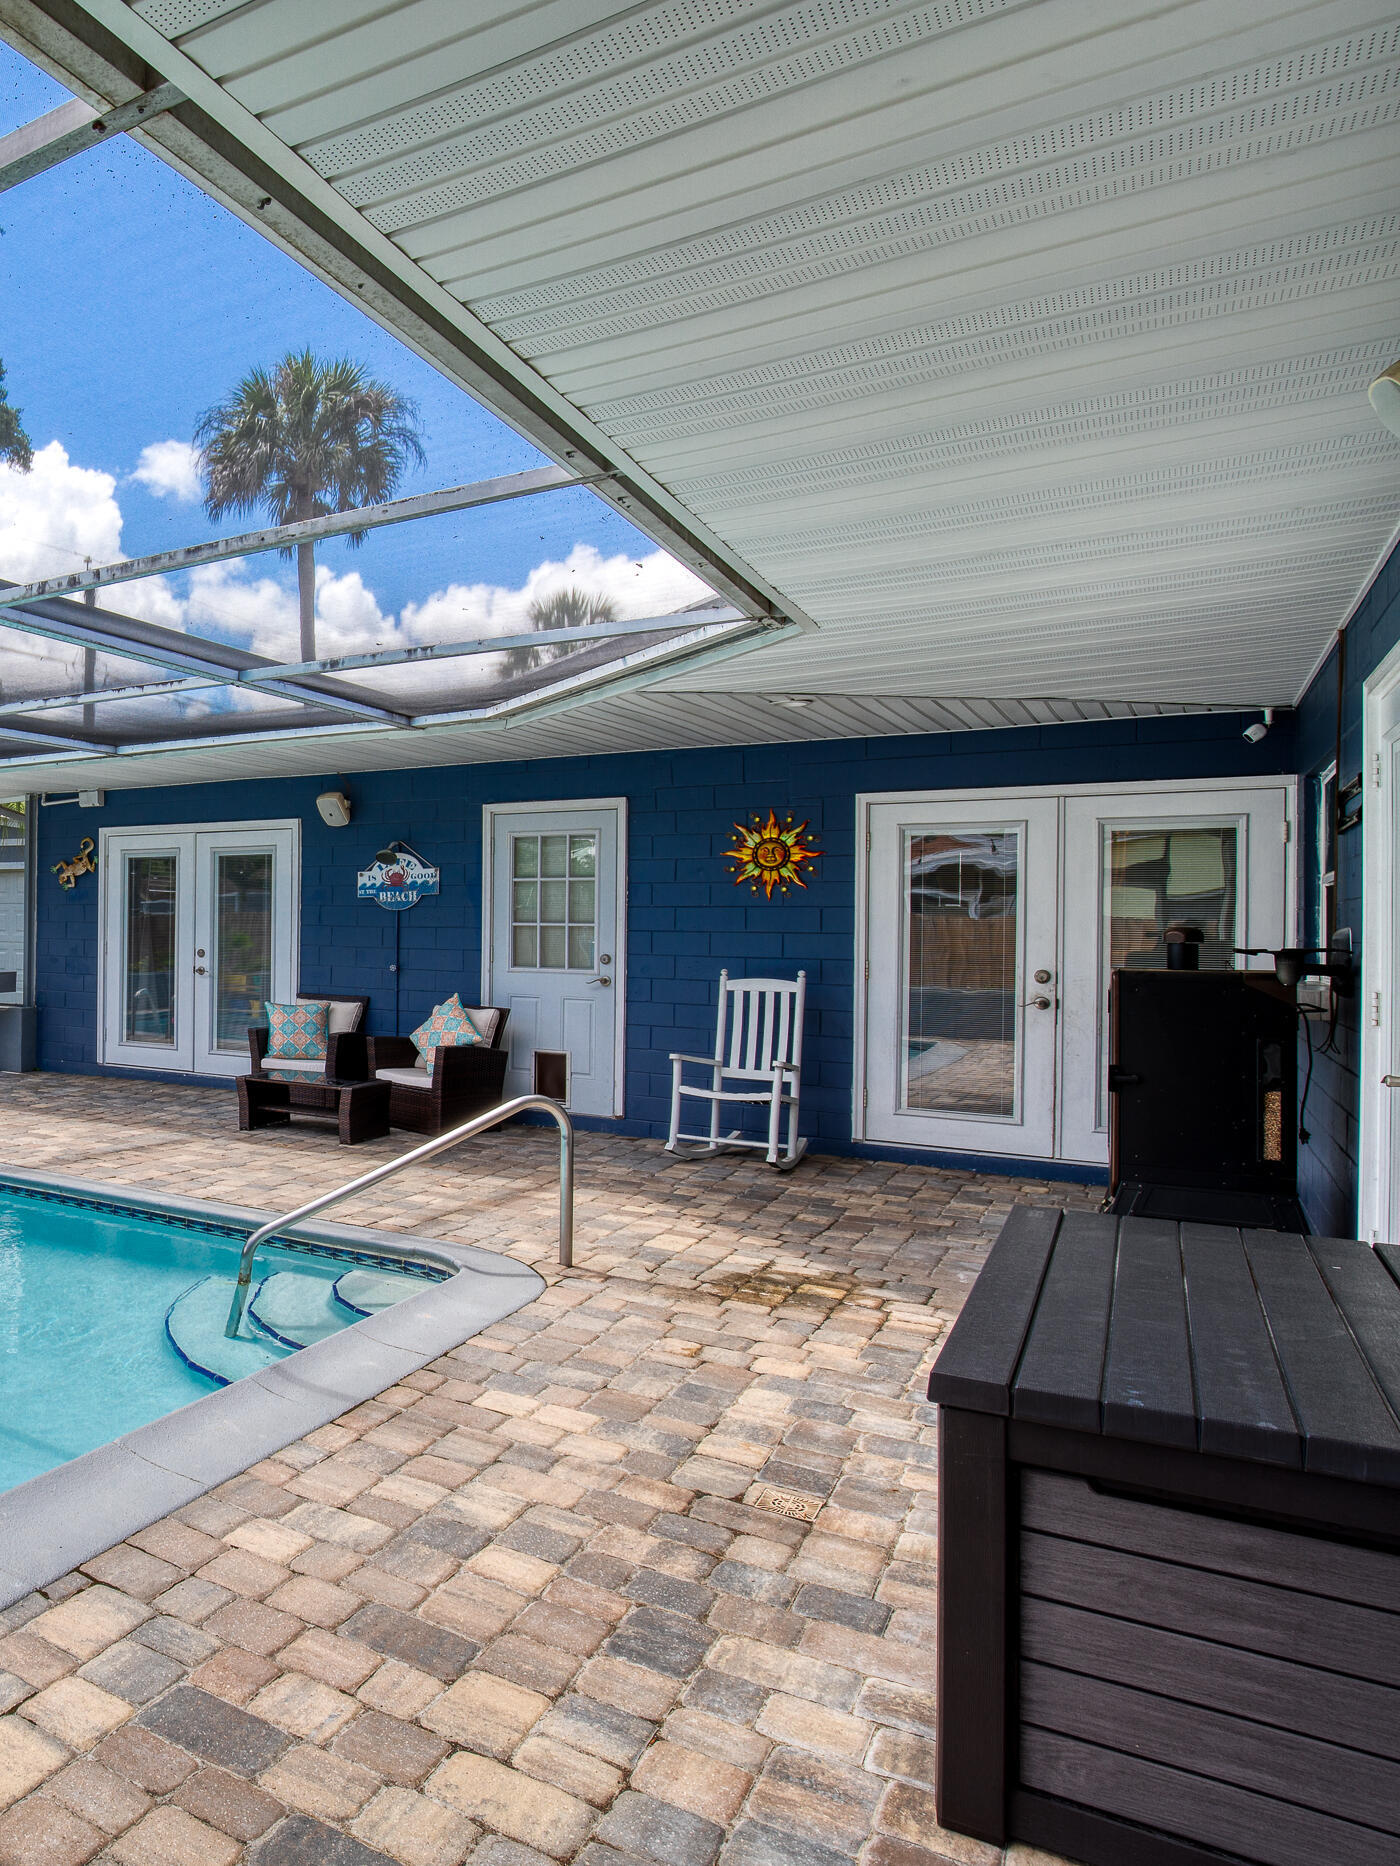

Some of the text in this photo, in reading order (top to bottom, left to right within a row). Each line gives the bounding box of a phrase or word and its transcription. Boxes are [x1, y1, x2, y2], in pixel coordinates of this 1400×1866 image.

[377, 858, 417, 871] LFE
[410, 872, 437, 880] GOOD
[379, 890, 418, 902] BEACH
